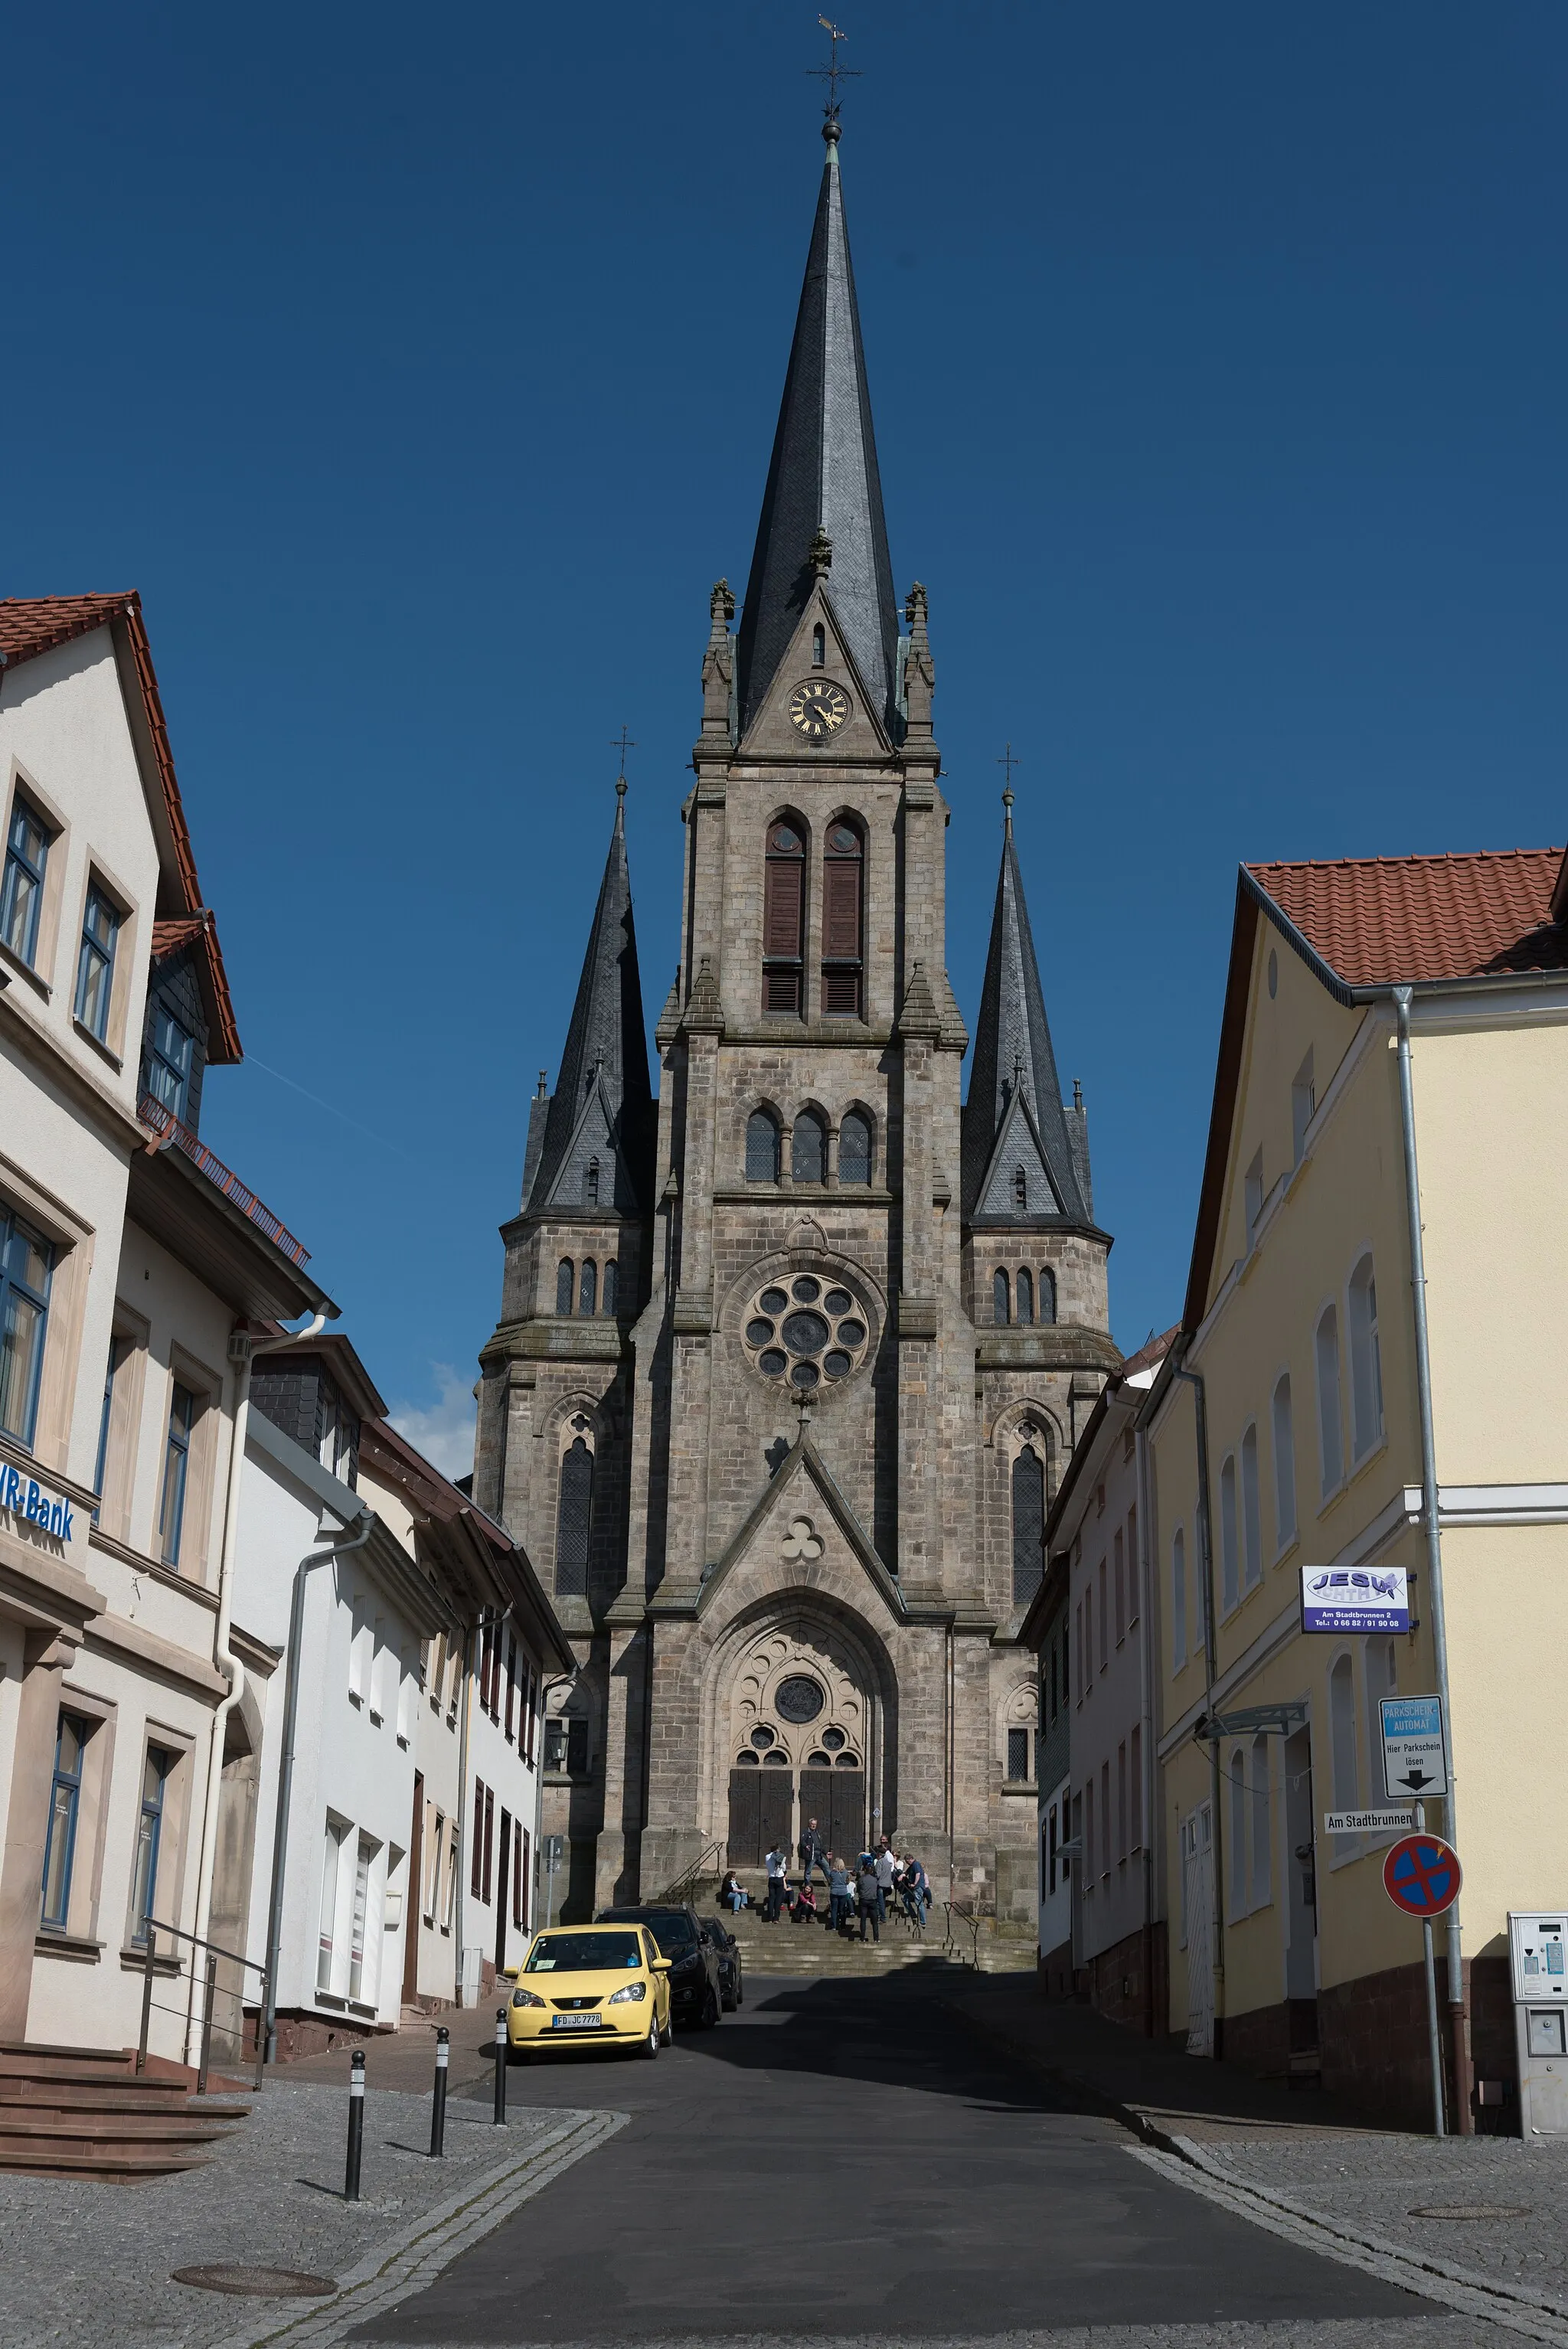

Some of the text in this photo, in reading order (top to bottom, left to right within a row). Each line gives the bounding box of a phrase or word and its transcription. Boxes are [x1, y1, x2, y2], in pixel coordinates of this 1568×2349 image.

[1384, 1706, 1437, 1717] PARKSCHEIN-
[1393, 1719, 1429, 1731] AUTOMAT
[1387, 1742, 1440, 1753] Hier Parkschein
[1406, 1757, 1424, 1766] lösen
[1328, 1814, 1412, 1828] Am Stadtbrunnen
[582, 2015, 600, 2024] 7778
